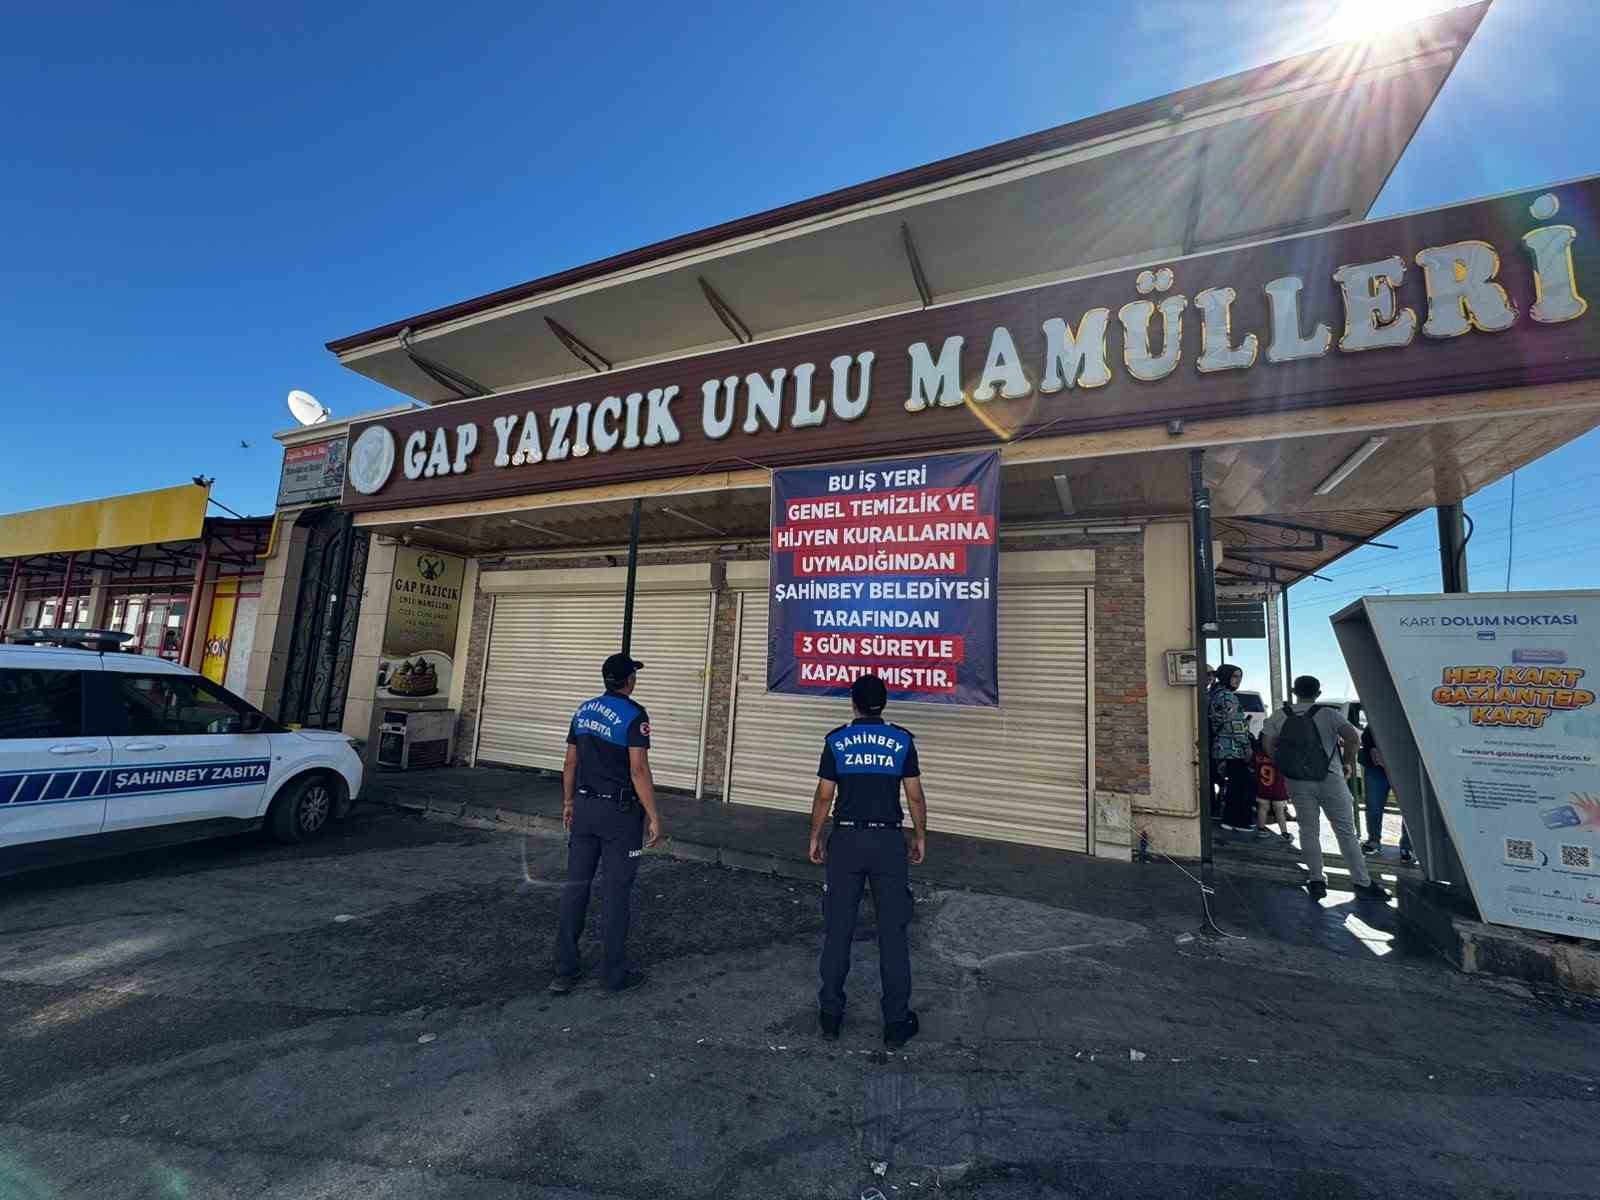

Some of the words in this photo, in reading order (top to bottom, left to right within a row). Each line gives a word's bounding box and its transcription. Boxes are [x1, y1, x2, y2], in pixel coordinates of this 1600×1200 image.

[403, 422, 478, 480] GAP
[494, 385, 680, 467] YAZICIK
[701, 351, 875, 439] UNLU
[904, 193, 1587, 412] MAMÜLLERİ
[828, 475, 854, 492] BU
[858, 471, 877, 491] İŞ
[882, 465, 927, 488] YERİ
[788, 502, 846, 521] GENEL
[851, 492, 942, 517] TEMİZLİK
[946, 493, 975, 511] VE
[777, 527, 839, 548] HİJYEN
[843, 522, 989, 545] KURALLARINA
[802, 550, 955, 573] UYMADIĞINDAN
[395, 579, 417, 592] GAP
[775, 580, 864, 602] ŞAHİNBEY
[869, 577, 990, 600] BELEDİYESİ
[813, 609, 940, 629] TARAFINDAN
[1399, 616, 1437, 627] KART
[1440, 615, 1499, 626] DOLUM
[1503, 614, 1578, 626] NOKTASI
[802, 637, 812, 653] 3
[816, 634, 856, 655] GÜN
[860, 635, 953, 658] SÜREYLE
[1443, 666, 1499, 686] HER
[1501, 666, 1585, 688] KART
[577, 718, 612, 737] ZABITA
[1470, 706, 1552, 728] KART
[834, 731, 904, 753] ŞAHİNBEY
[844, 753, 894, 768] ZABITA
[211, 765, 266, 780] ZABITA
[1260, 765, 1273, 786] 9
